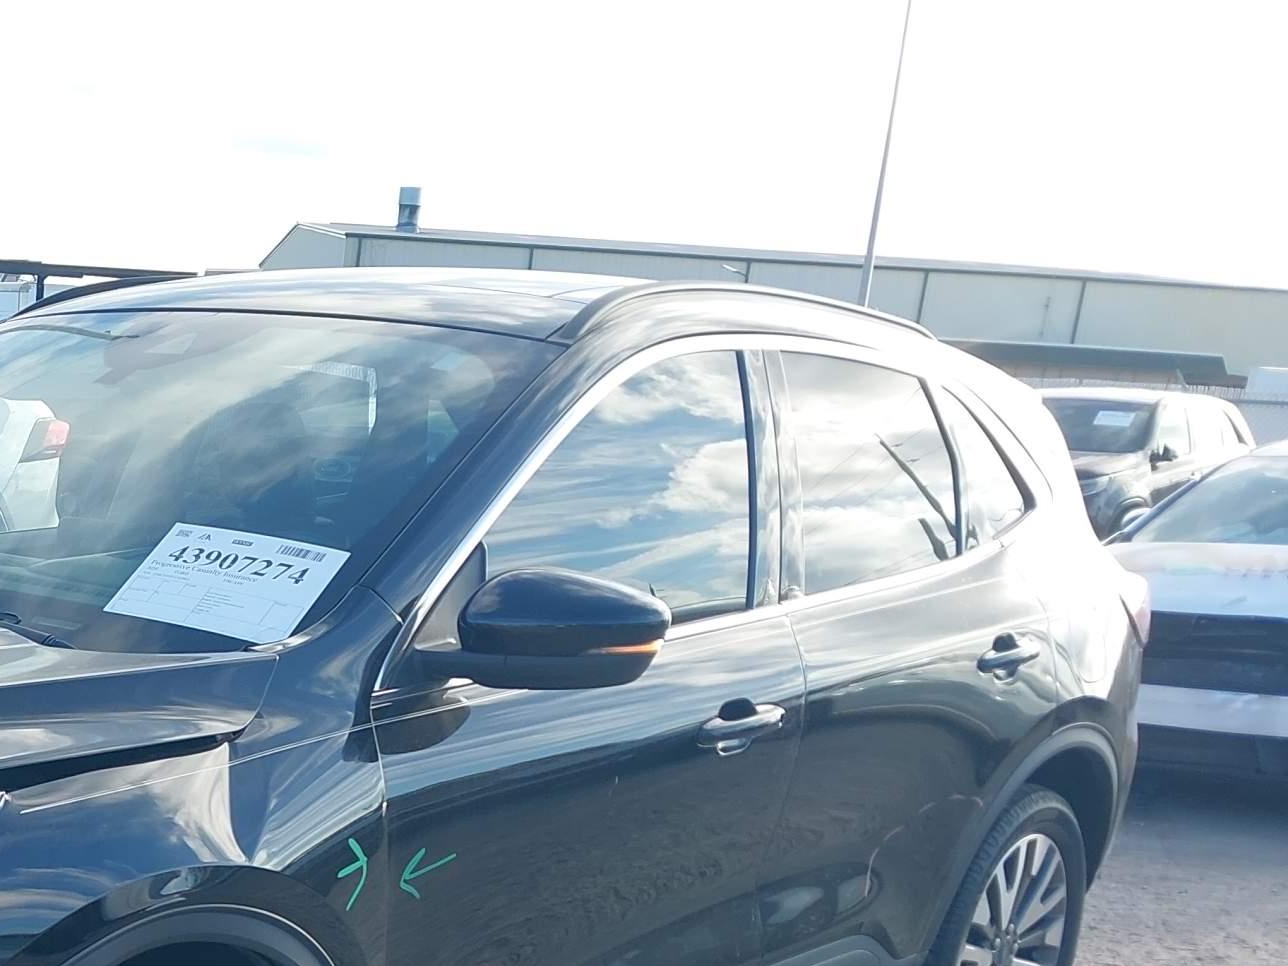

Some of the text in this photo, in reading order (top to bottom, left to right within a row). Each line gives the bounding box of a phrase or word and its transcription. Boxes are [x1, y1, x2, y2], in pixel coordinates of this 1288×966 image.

[150, 559, 191, 571] Progressive
[223, 571, 259, 583] Insurance
[168, 545, 311, 586] 43907274
